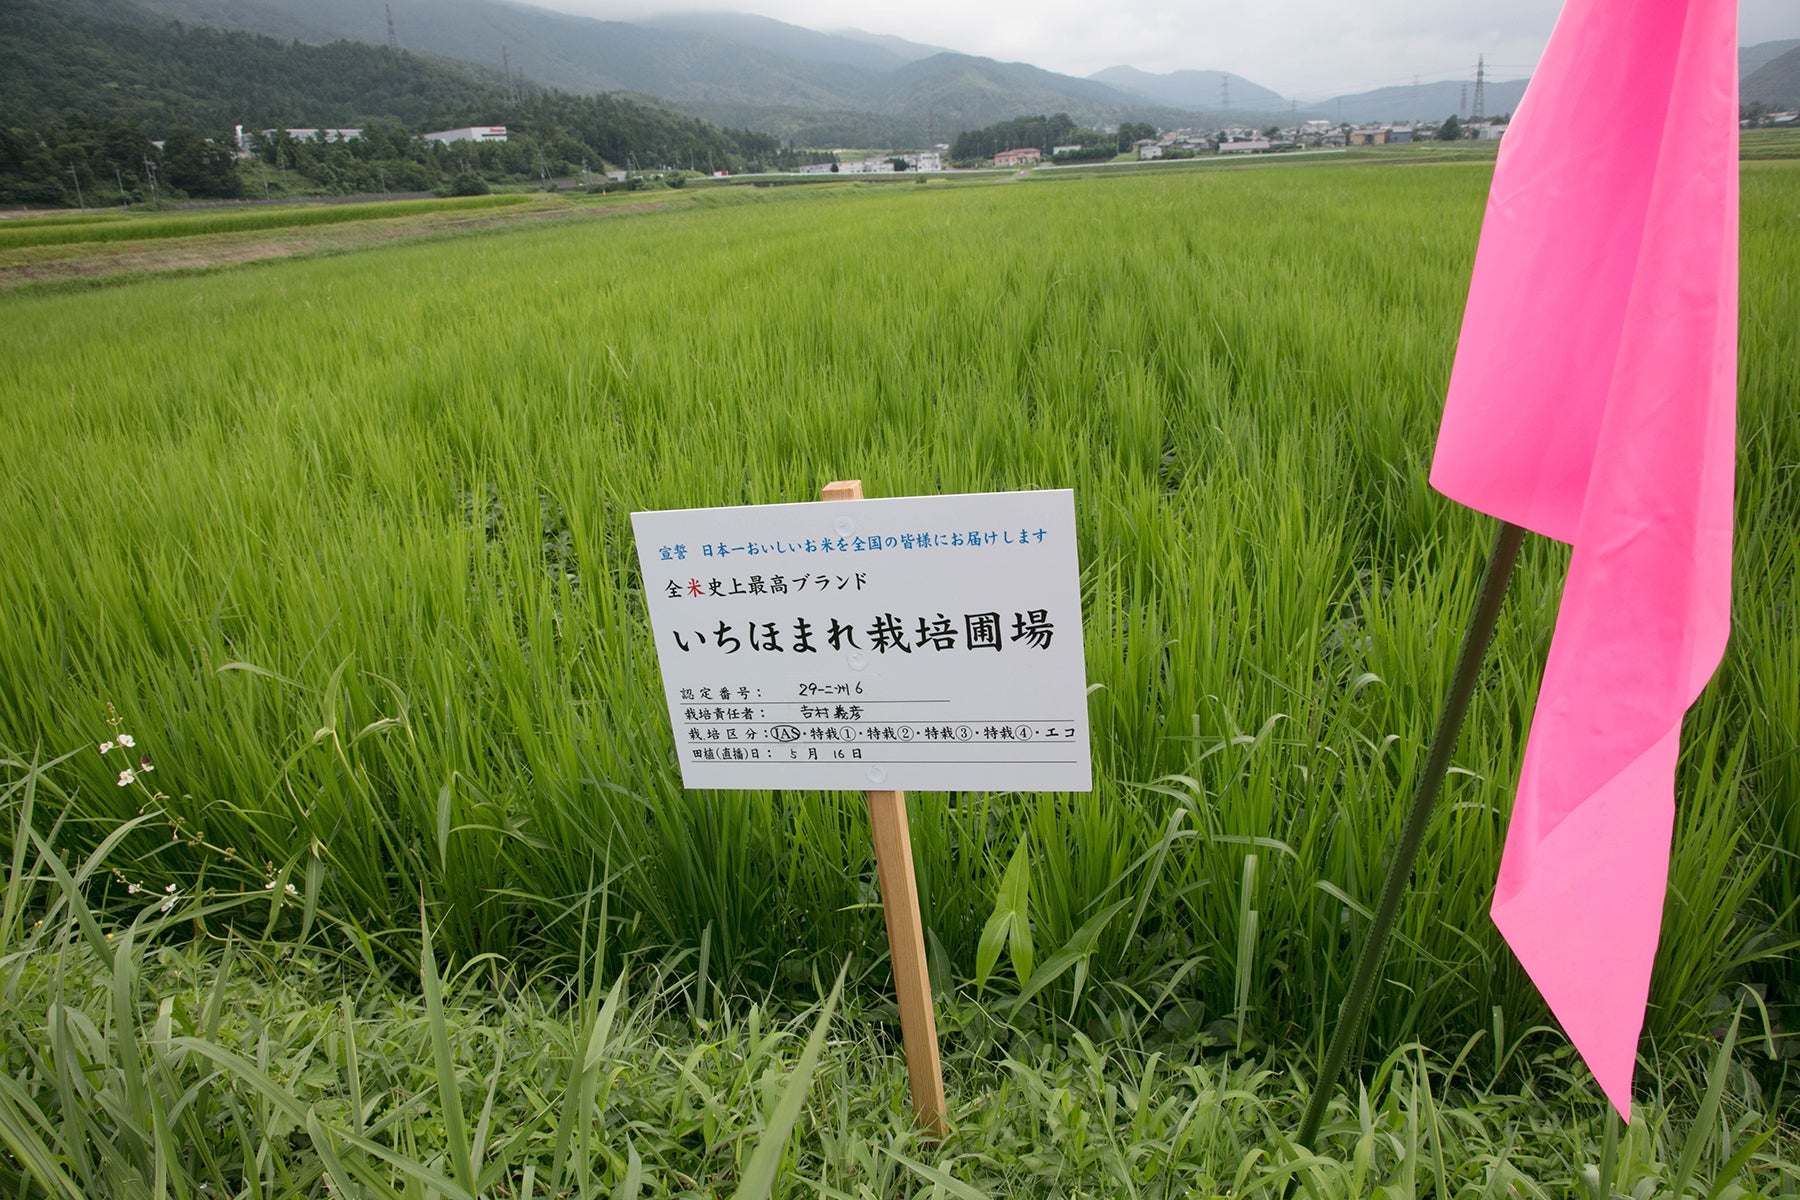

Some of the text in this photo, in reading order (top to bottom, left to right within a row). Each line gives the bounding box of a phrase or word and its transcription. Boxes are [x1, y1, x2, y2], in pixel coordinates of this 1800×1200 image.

[659, 528, 1048, 561] 宣誓 日本一おいしいお米を全国の皆様にお届けします
[664, 572, 868, 599] 全米史上最高ブランド
[672, 608, 1055, 655] いちほまれ栽培圃場
